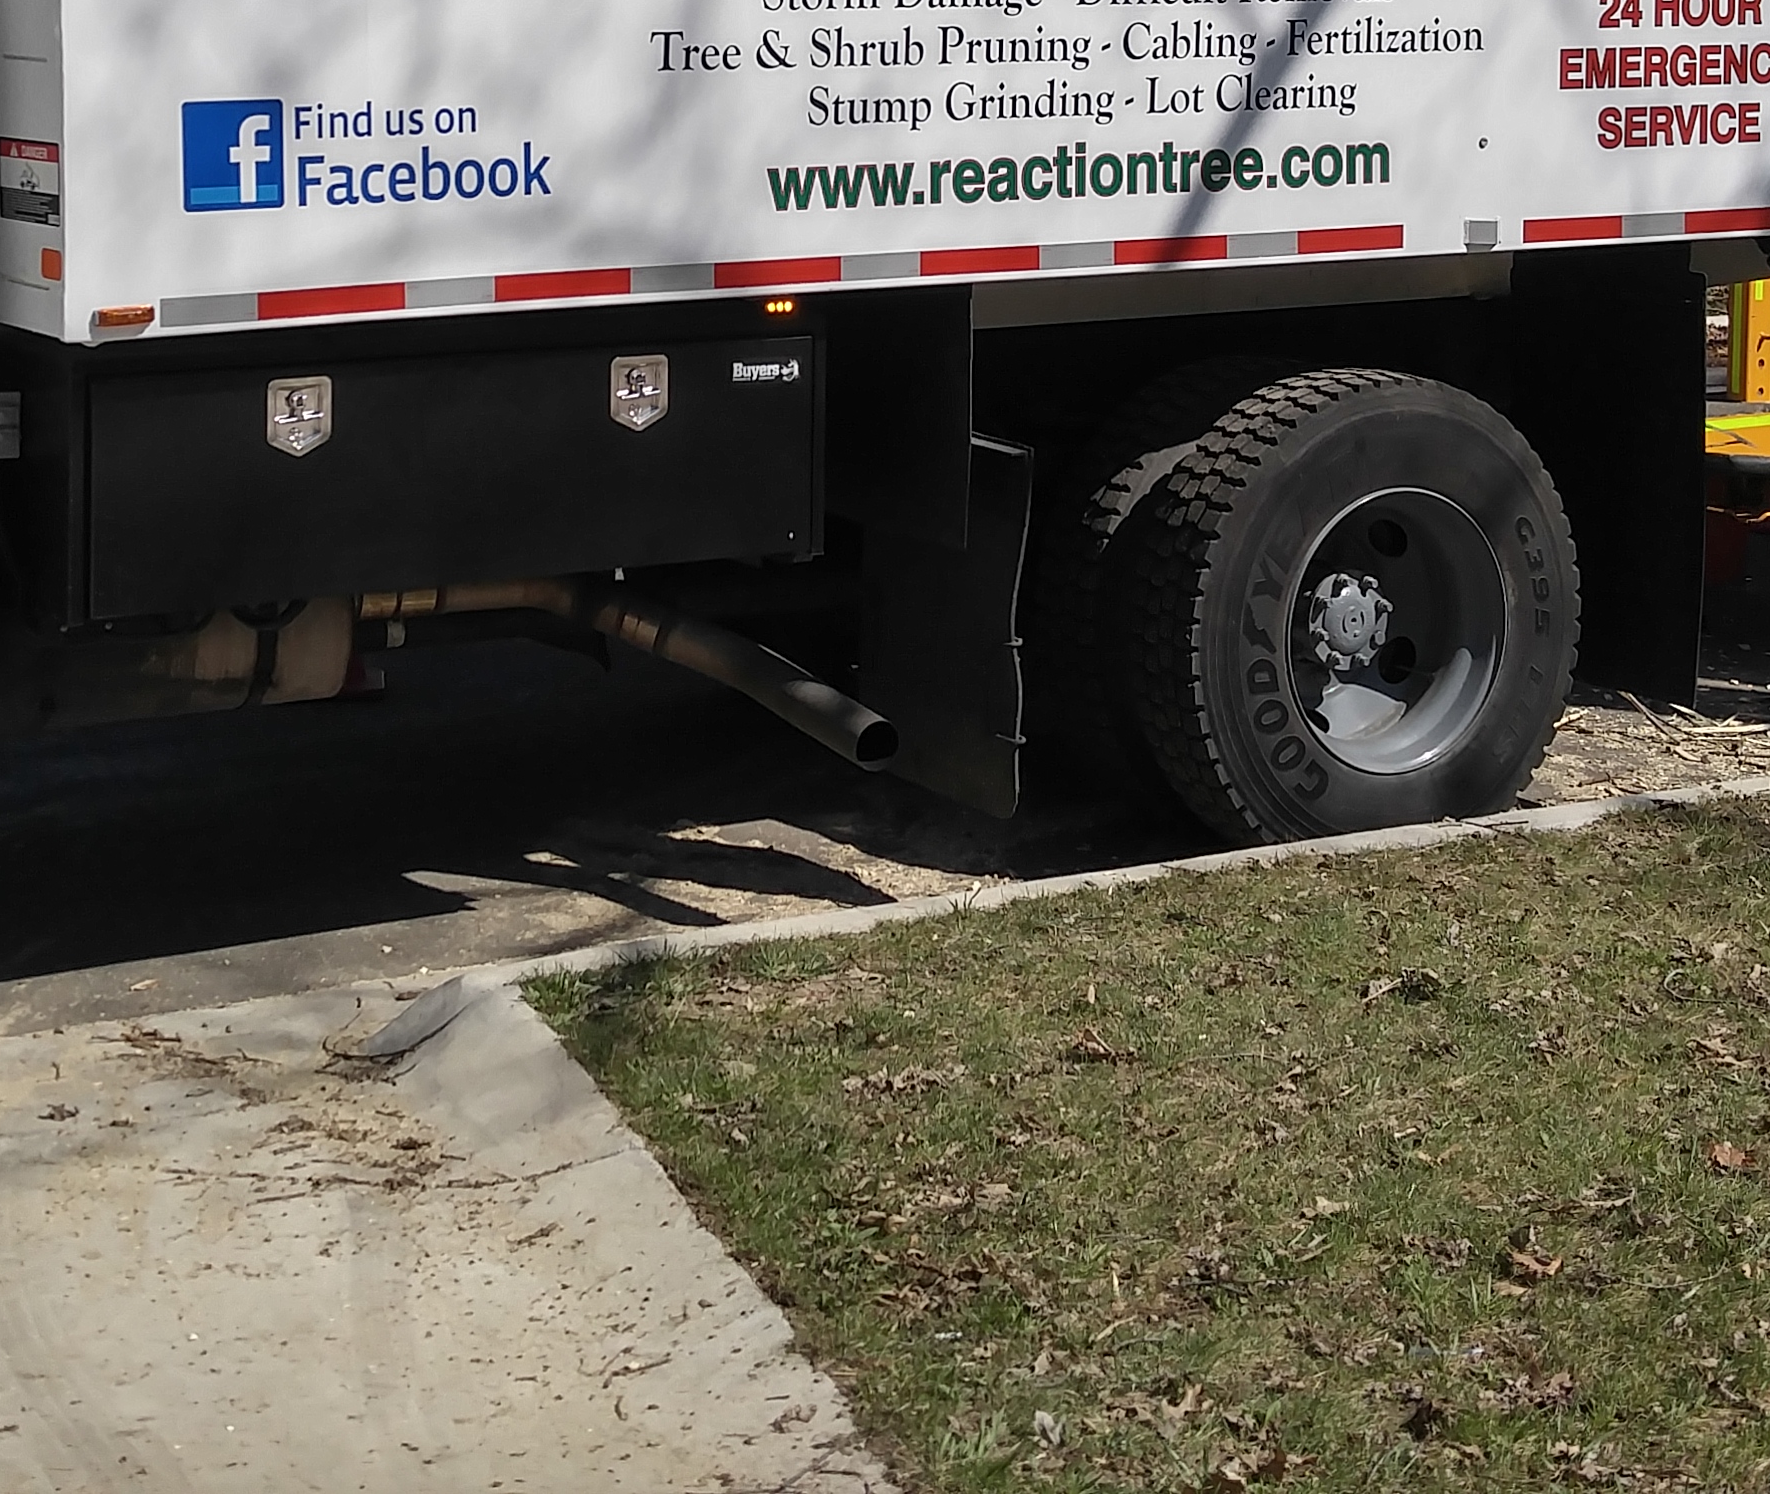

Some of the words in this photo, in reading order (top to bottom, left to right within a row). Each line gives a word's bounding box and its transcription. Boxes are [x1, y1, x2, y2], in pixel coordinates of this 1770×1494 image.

[651, 31, 740, 71] Tree
[757, 30, 796, 68] &
[810, 26, 923, 67] Shrub
[938, 26, 1090, 70] Pruning
[1123, 20, 1256, 65] Cabling
[1287, 17, 1484, 58] Fertilization
[295, 101, 371, 139] Find
[386, 110, 423, 135] us
[435, 108, 476, 133] on
[808, 86, 931, 130] Stump
[946, 79, 1114, 124] Grinding
[1146, 77, 1204, 113] Lot
[1216, 75, 1359, 118] Clearing
[1598, 103, 1760, 149] SERVICE
[298, 142, 551, 206] Facebook
[767, 139, 1393, 214] www.reactiontree.com
[732, 362, 780, 381] Buyers
